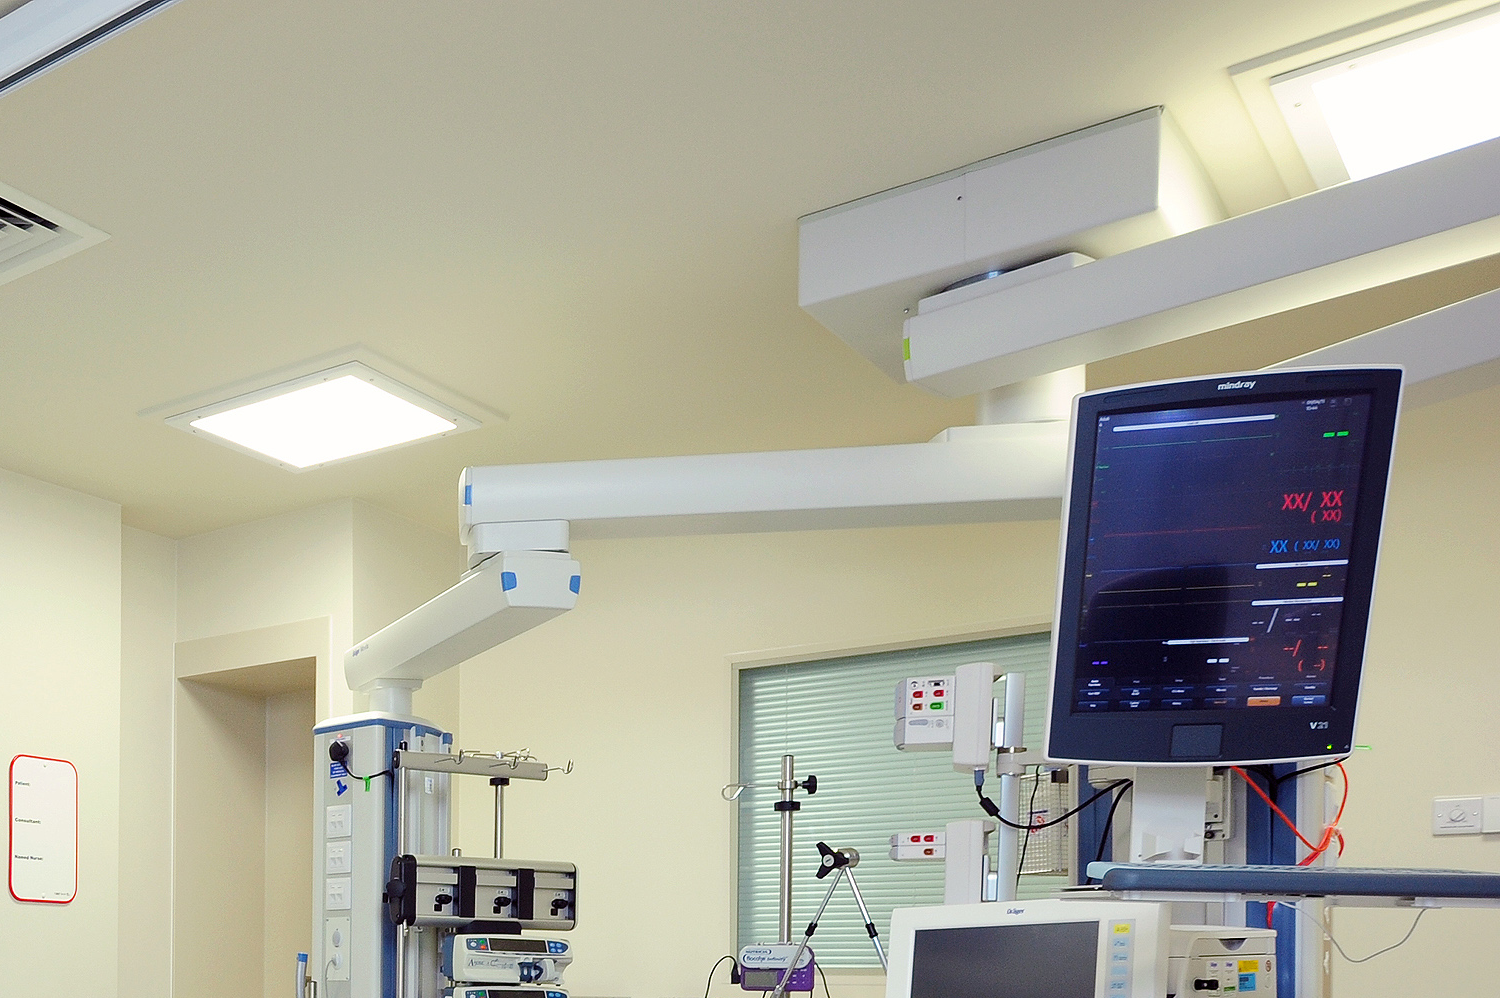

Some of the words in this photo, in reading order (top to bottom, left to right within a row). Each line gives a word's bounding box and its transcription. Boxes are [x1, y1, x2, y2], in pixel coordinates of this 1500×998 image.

[1217, 381, 1256, 391] mindray
[1281, 491, 1313, 512] XX/
[1320, 489, 1344, 508] XX
[1269, 539, 1288, 554] XX
[1309, 721, 1329, 730] V21
